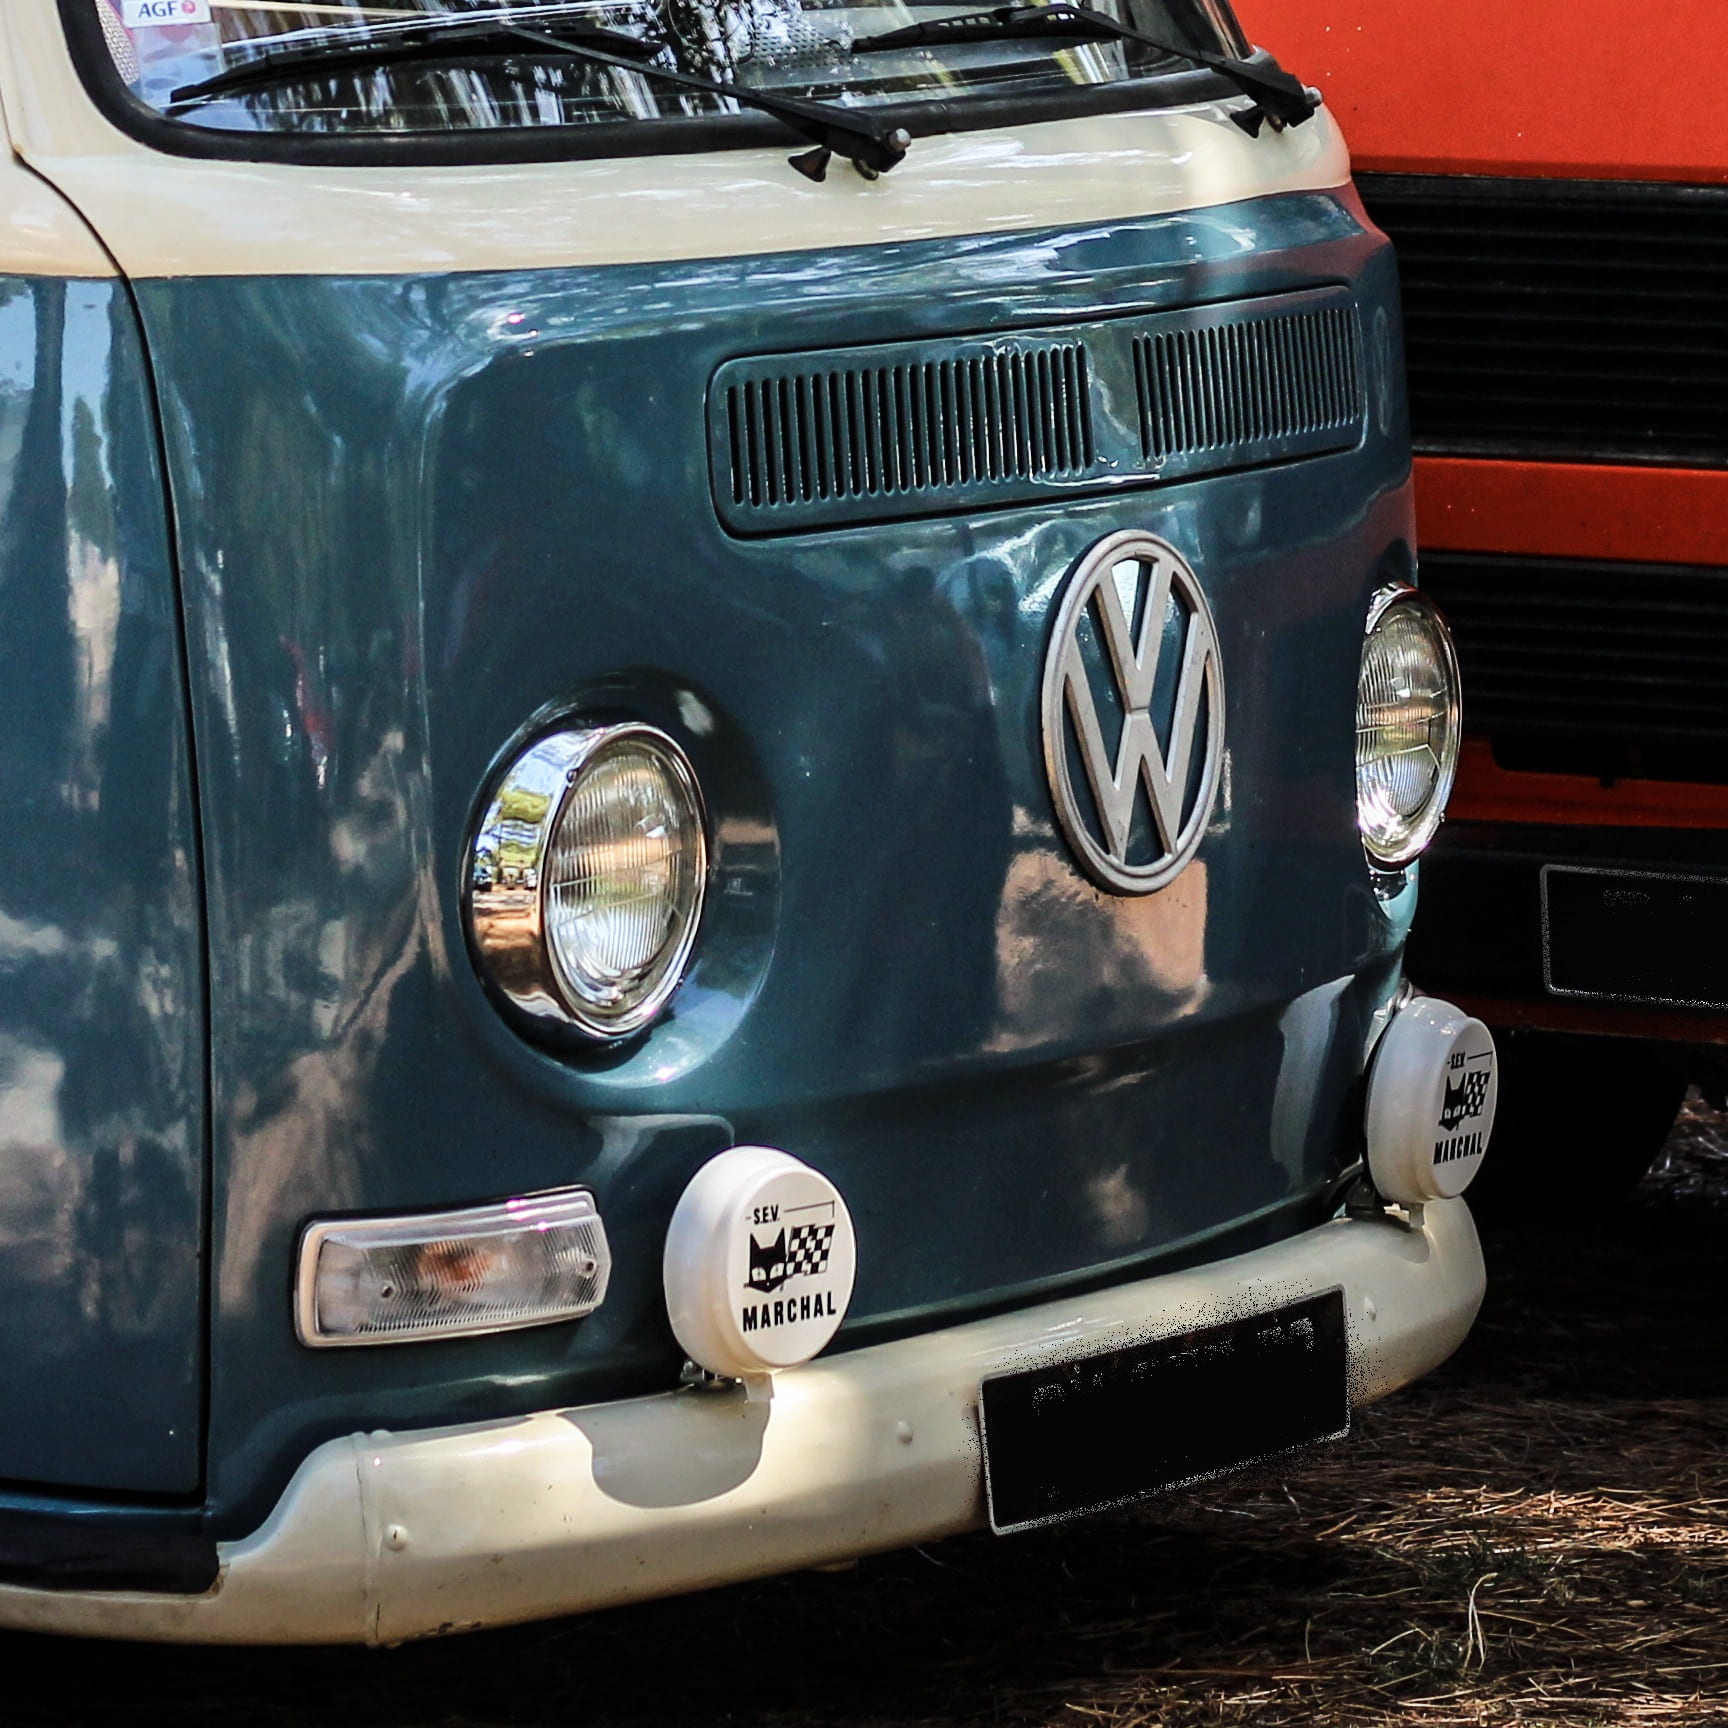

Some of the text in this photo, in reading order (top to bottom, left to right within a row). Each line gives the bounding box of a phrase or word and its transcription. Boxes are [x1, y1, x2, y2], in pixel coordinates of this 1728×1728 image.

[138, 0, 177, 19] AGF
[1053, 542, 1219, 882] VW
[1433, 1131, 1483, 1165] MARCHAL
[742, 1290, 837, 1333] MARCHAL
